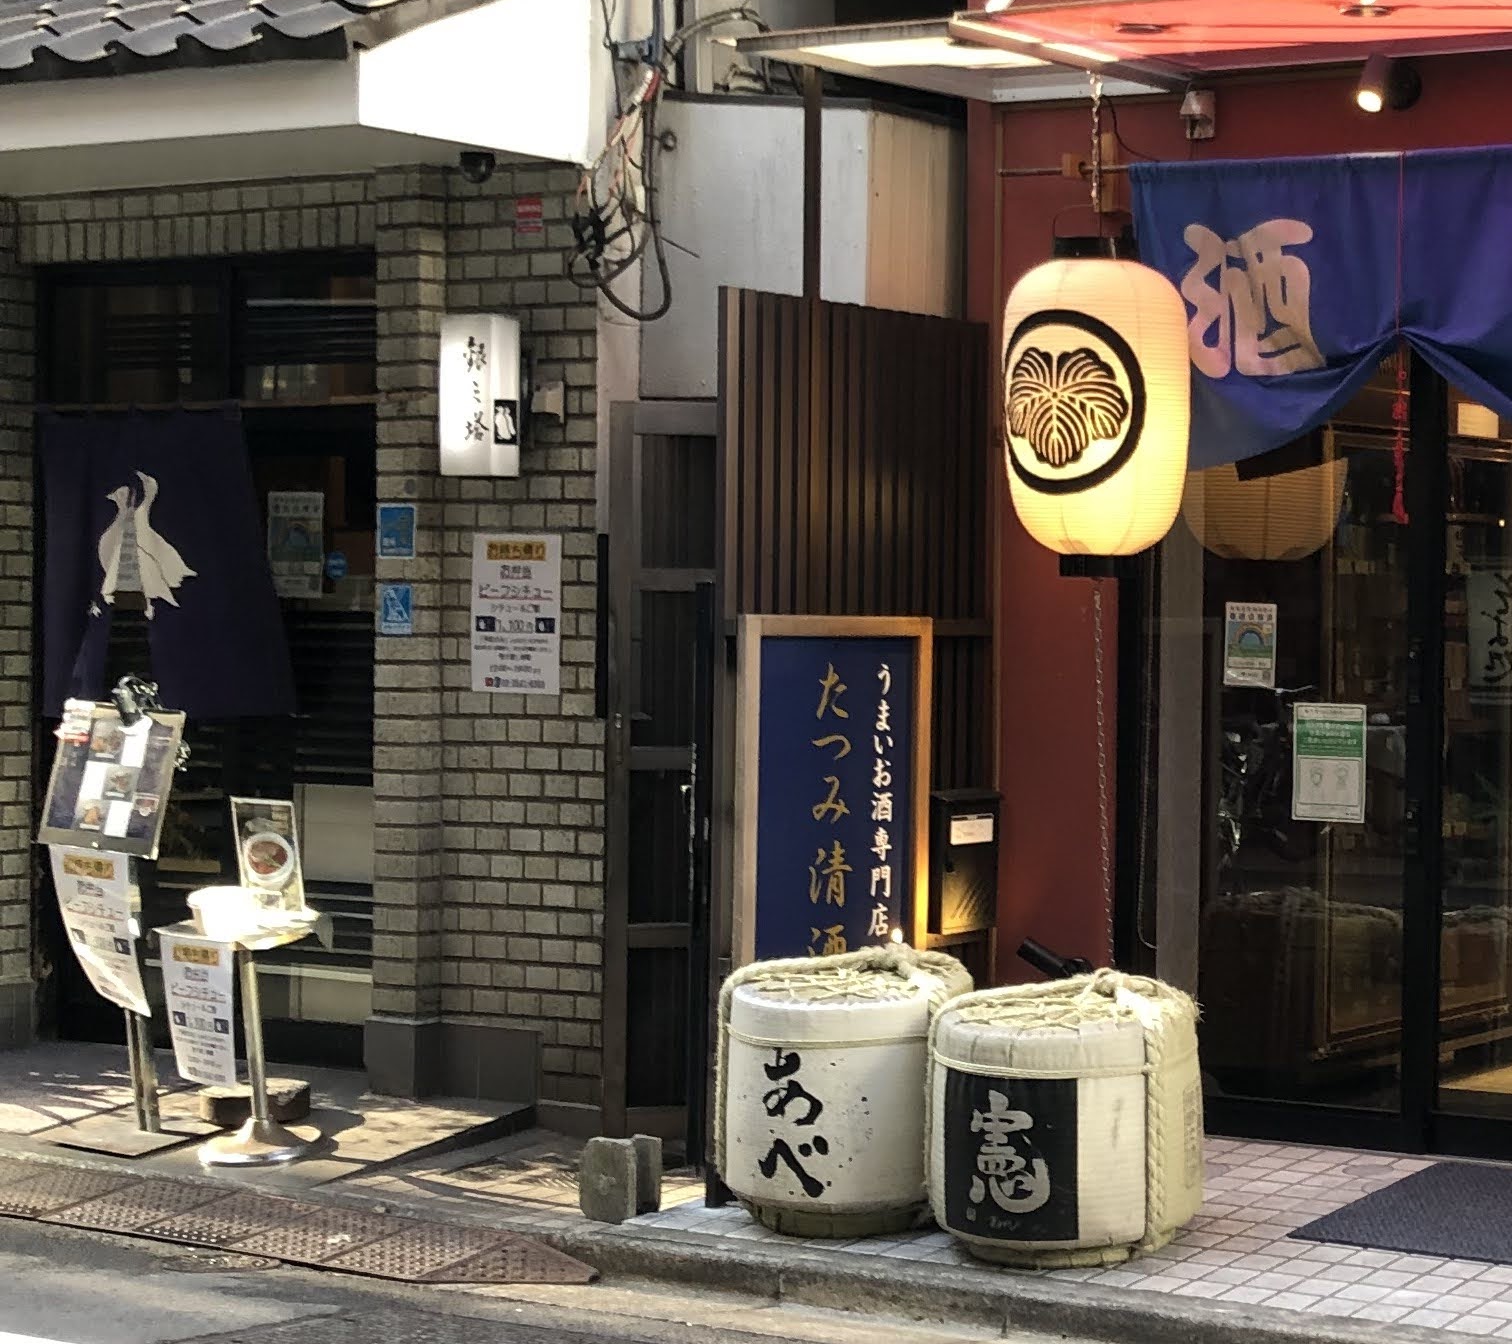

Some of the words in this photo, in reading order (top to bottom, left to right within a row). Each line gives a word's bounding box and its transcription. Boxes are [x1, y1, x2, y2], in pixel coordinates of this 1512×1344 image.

[1181, 218, 1327, 378] 酒
[867, 663, 894, 937] うまいお酒専門店
[758, 1047, 829, 1198] あべ
